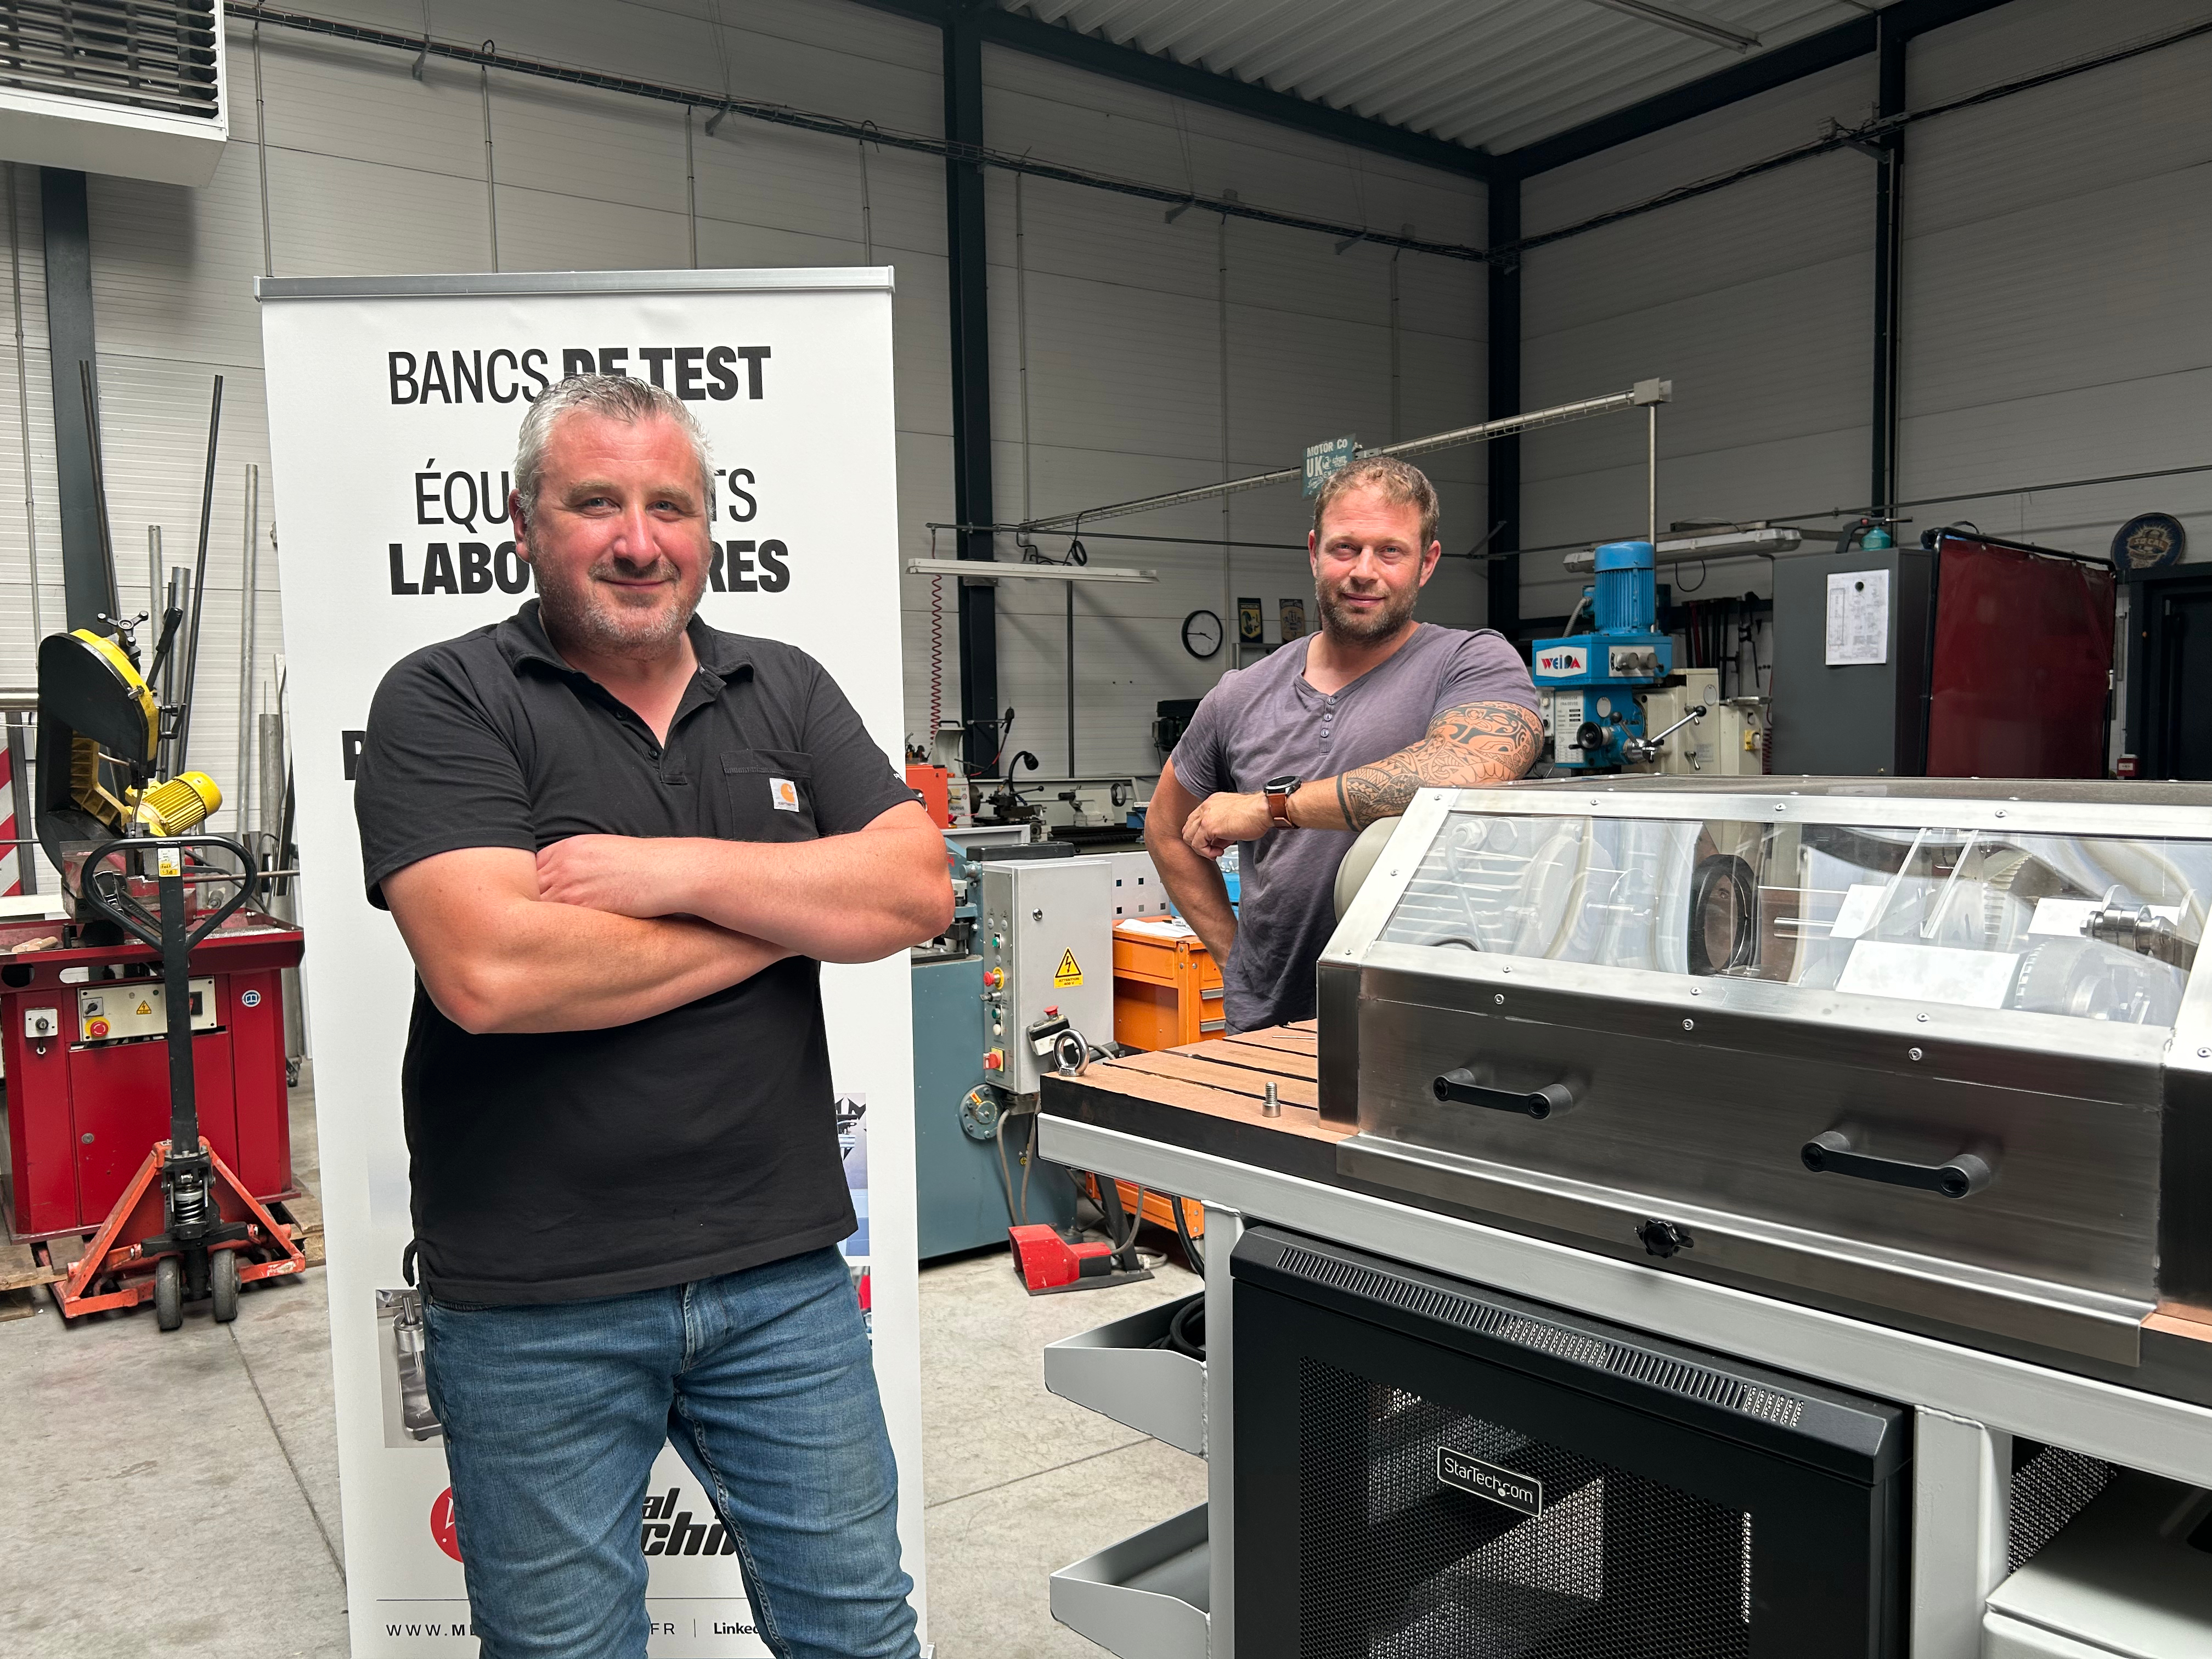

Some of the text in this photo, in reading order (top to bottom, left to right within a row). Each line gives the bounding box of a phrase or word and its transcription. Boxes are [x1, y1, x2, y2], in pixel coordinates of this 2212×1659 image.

[388, 348, 550, 404] BANCS
[639, 346, 771, 401] TEST
[1306, 438, 1348, 458] MOTOR CO
[1306, 455, 1323, 478] UK
[1444, 1457, 1533, 1504] StarTech.com
